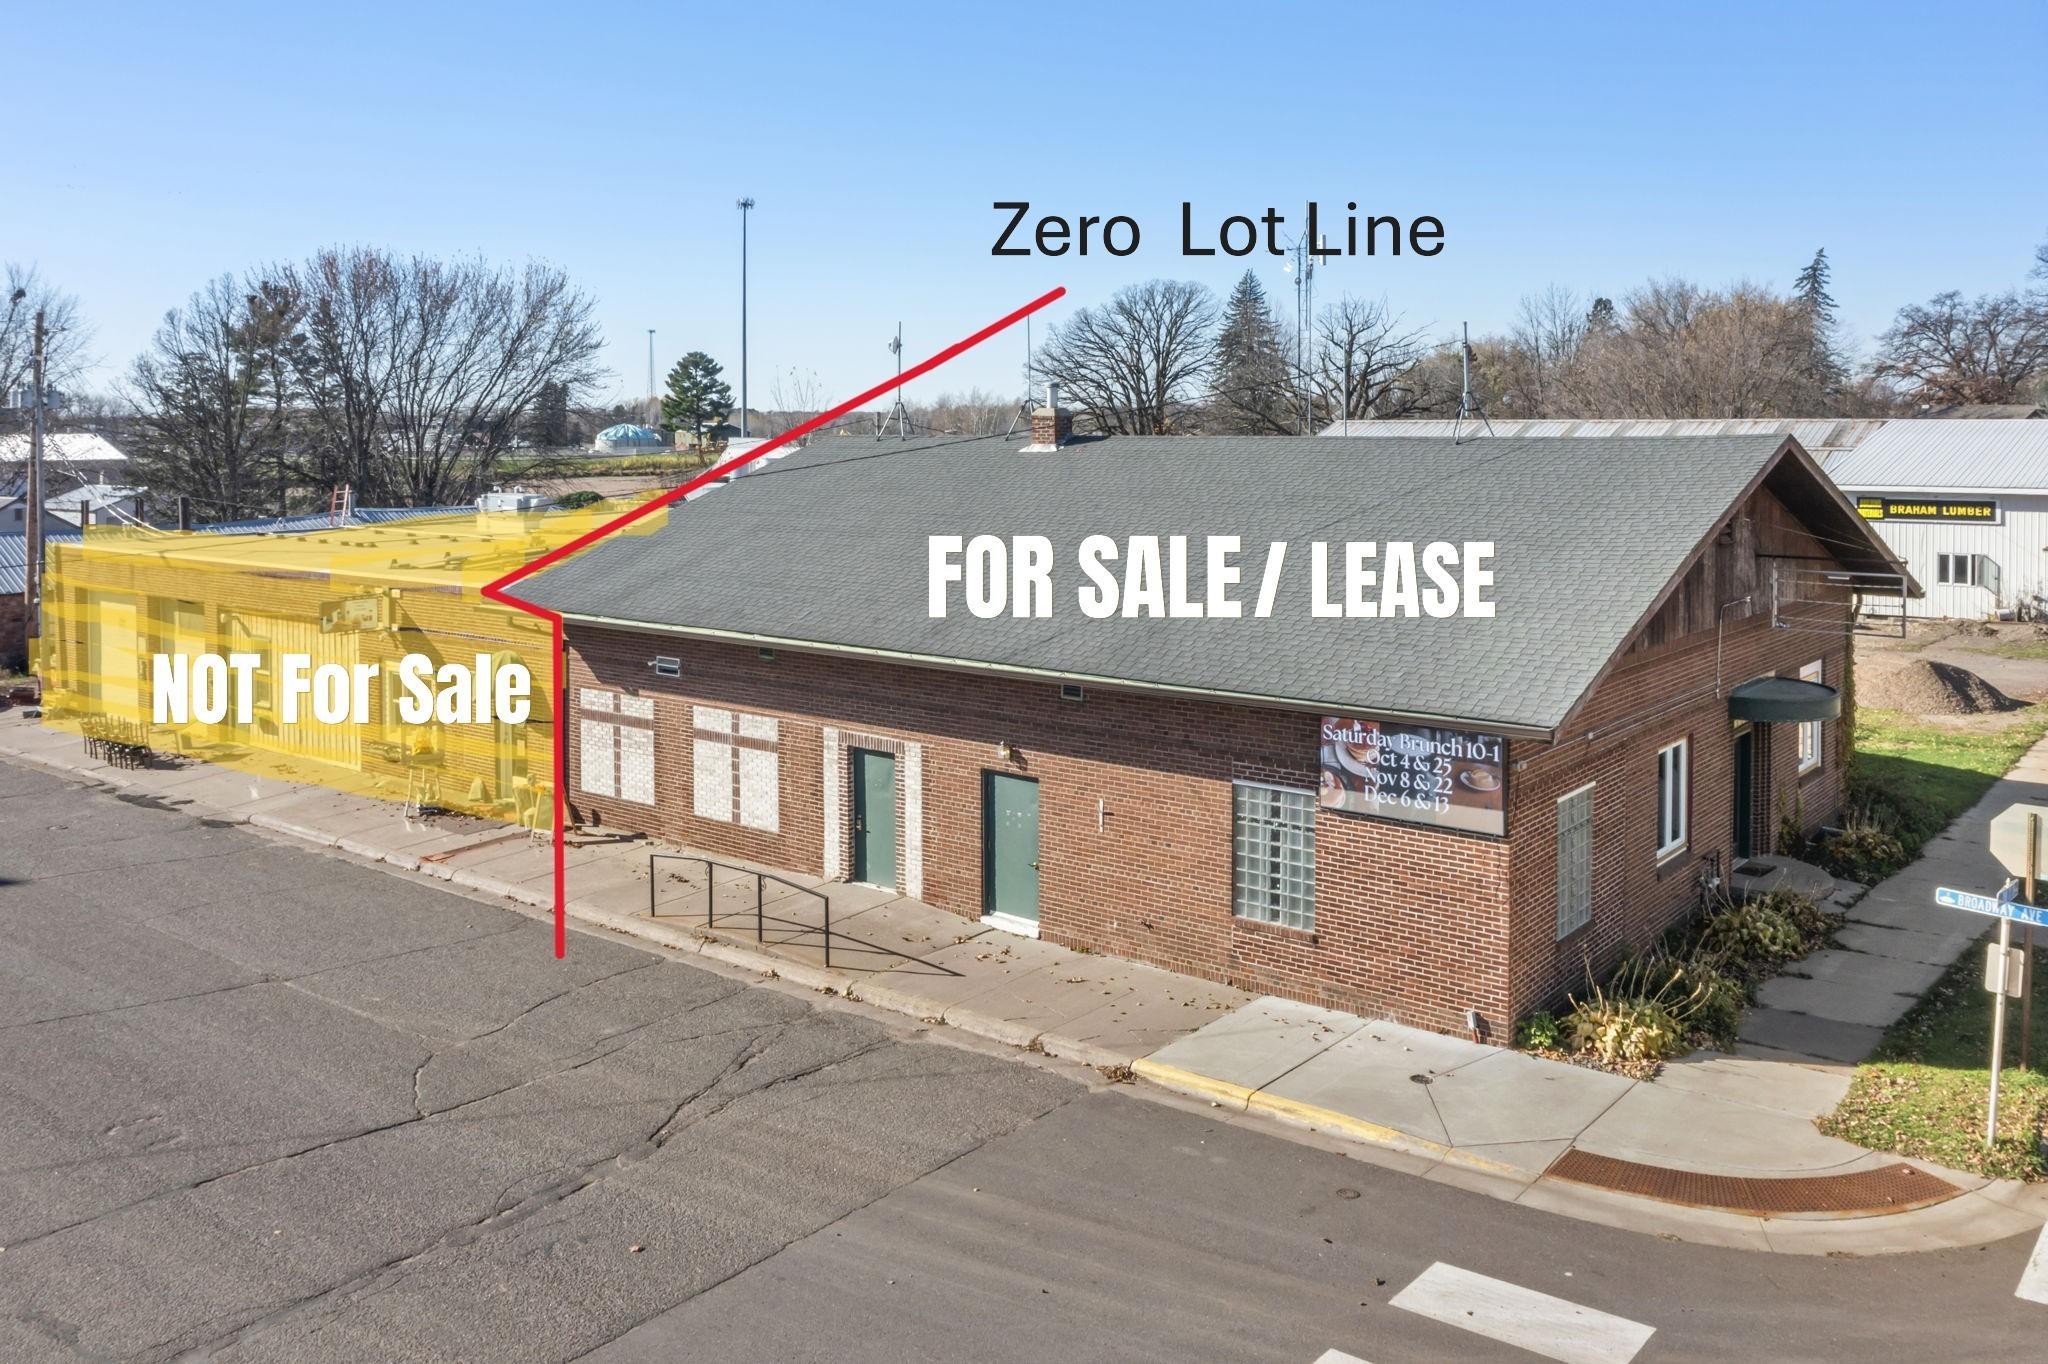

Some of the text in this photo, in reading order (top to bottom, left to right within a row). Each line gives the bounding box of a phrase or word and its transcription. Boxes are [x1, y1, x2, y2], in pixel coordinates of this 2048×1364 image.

[1889, 505, 1937, 515] BRAHAM
[1942, 506, 1991, 516] LUMBER
[1323, 724, 1500, 762] Saturday Brunch 10-1
[1366, 749, 1452, 776] Oct 4 & 25
[1365, 767, 1453, 794] Nov 8 & 22
[1364, 785, 1450, 815] Dec 6 & 13
[1957, 894, 2043, 923] BROADWAY AVE
